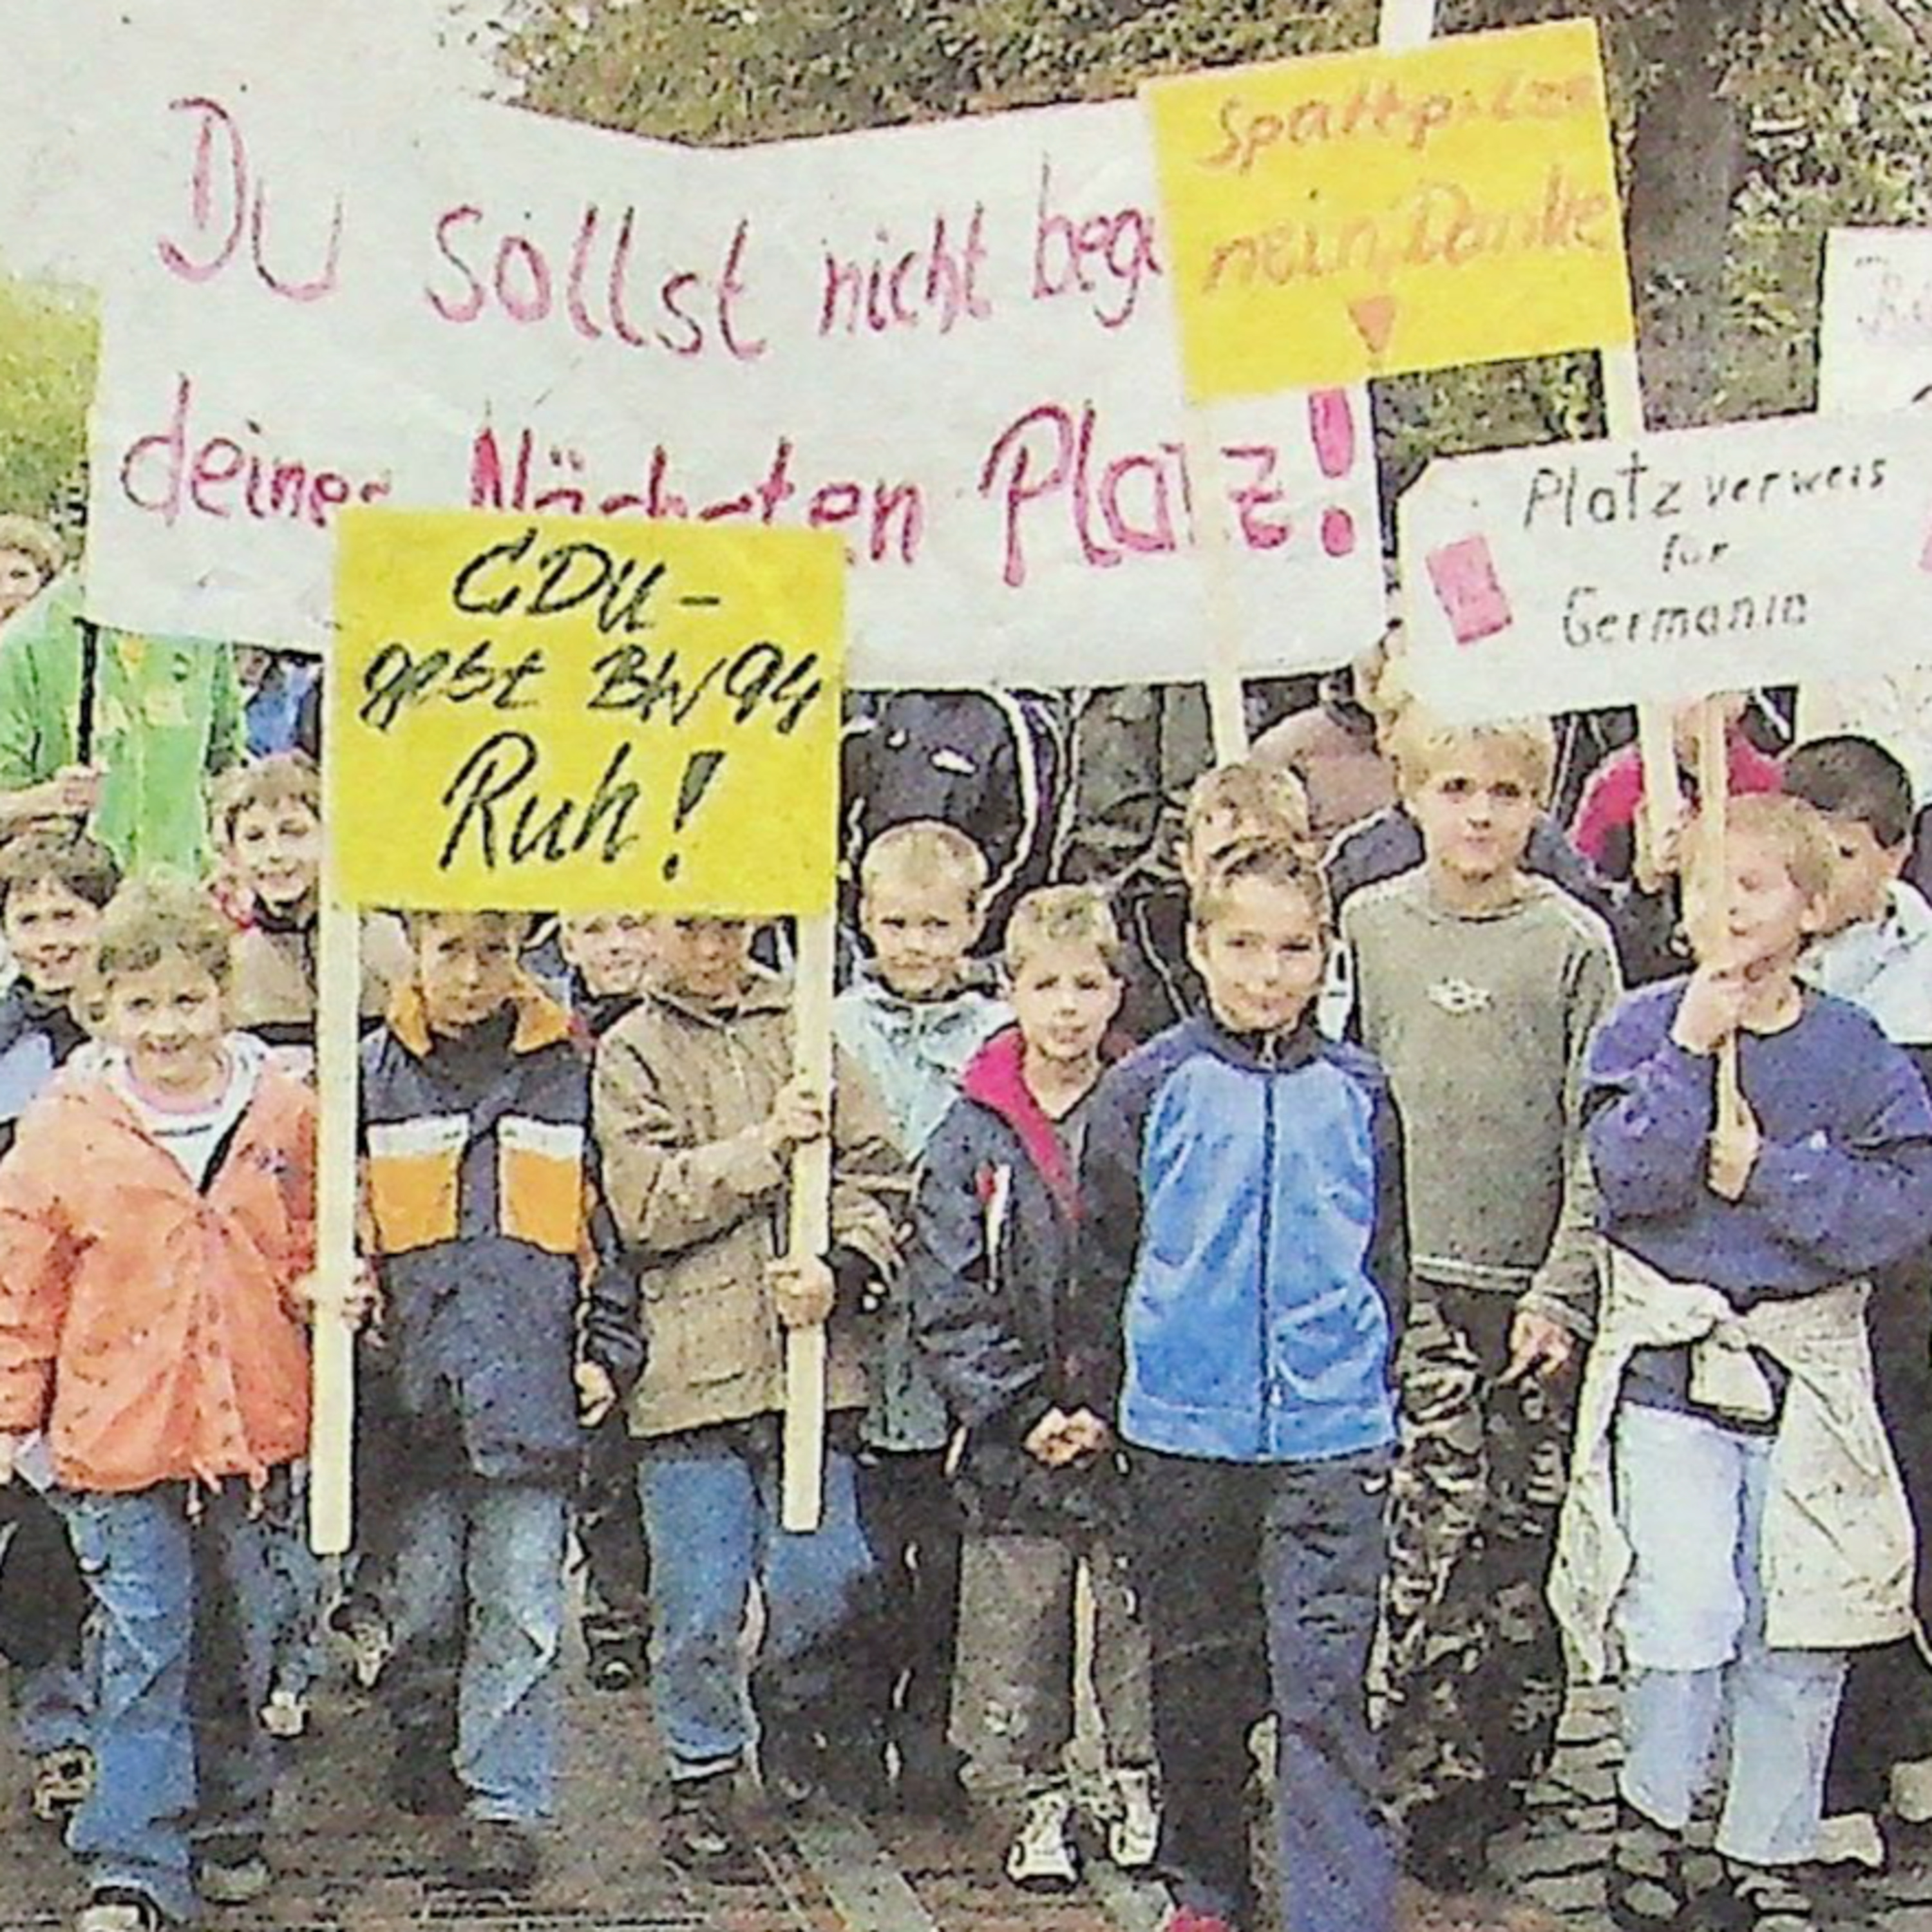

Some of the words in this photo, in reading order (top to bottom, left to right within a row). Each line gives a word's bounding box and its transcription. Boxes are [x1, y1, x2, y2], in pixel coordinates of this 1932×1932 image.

[425, 203, 767, 359] sollst
[819, 200, 991, 336] nicht
[1562, 586, 1807, 645] Germania
[439, 730, 726, 880] Ruh!
